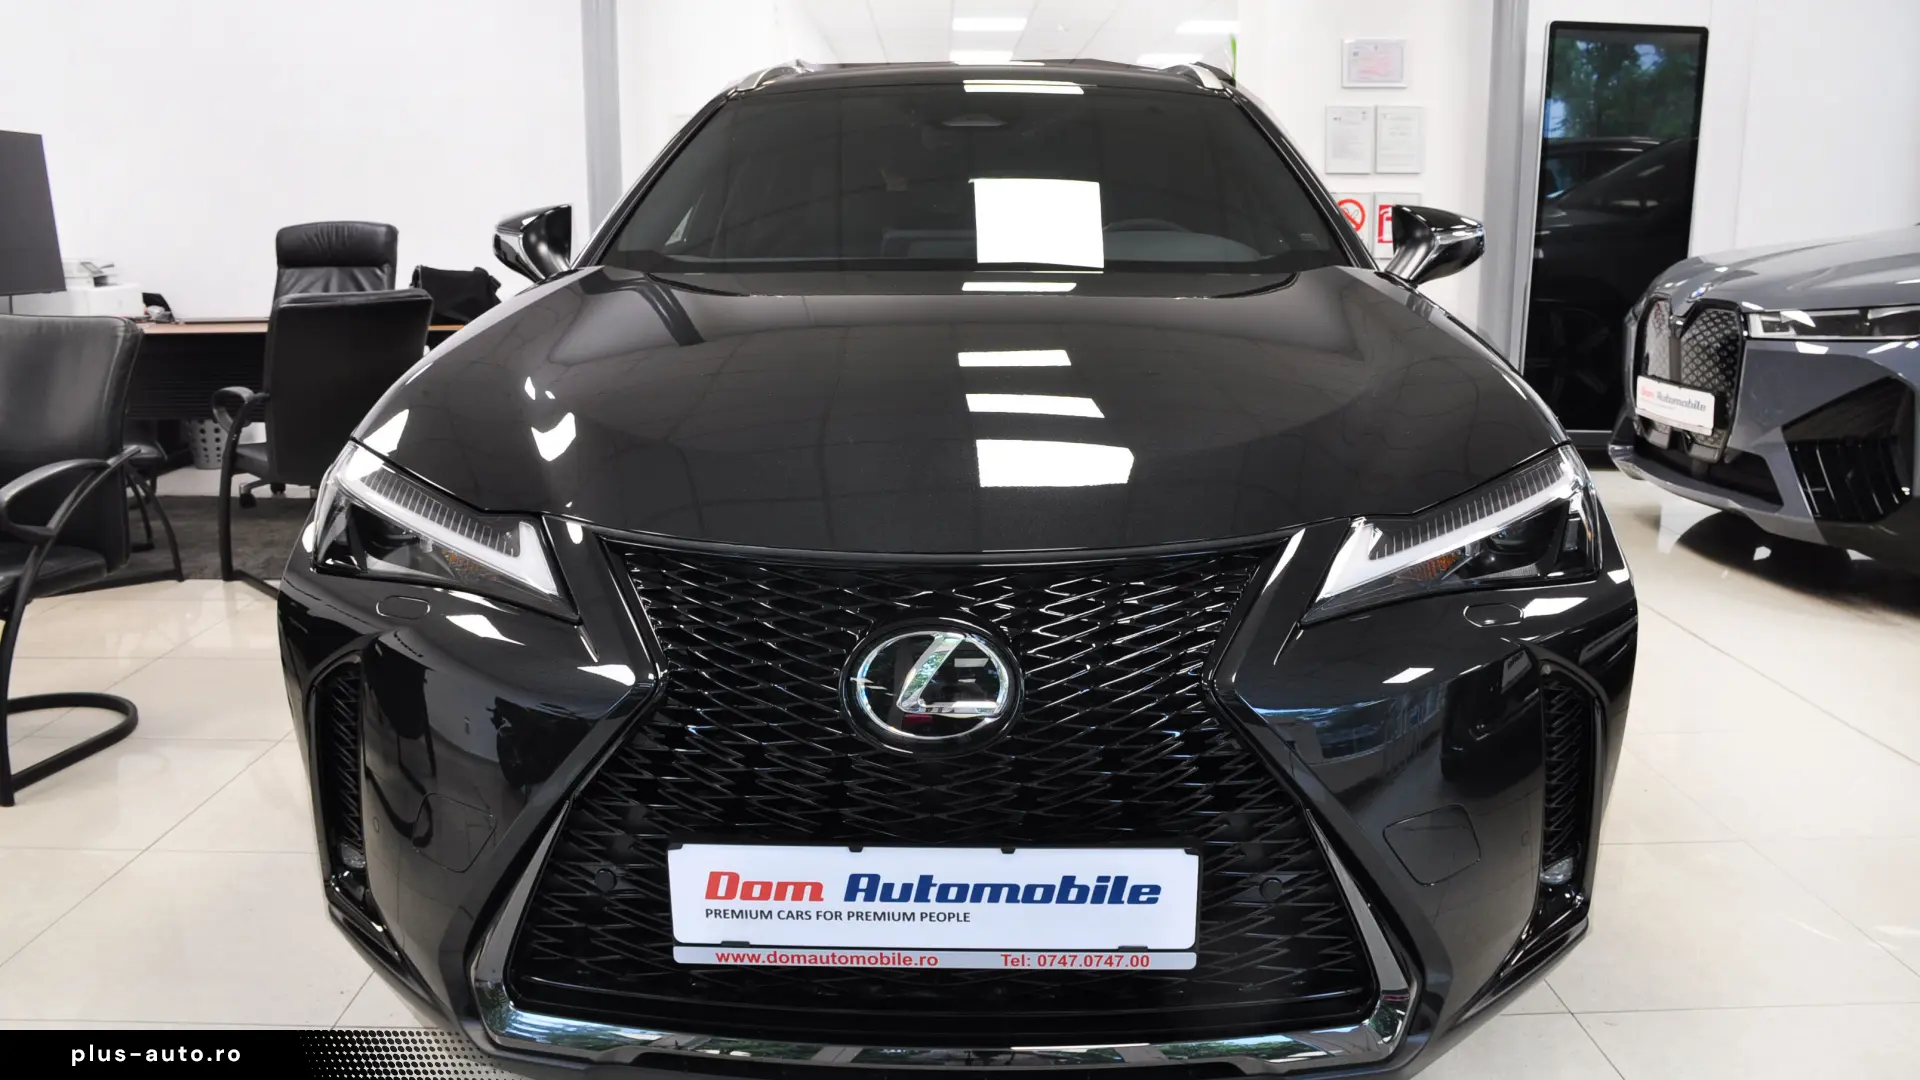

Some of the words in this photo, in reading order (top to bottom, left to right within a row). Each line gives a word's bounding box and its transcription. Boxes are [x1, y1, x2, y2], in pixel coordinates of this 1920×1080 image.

[705, 871, 824, 902] Dom
[843, 873, 1162, 905] Automobile
[705, 908, 773, 920] PREMIUM
[777, 909, 812, 921] CARS
[816, 910, 843, 921] FOR
[847, 911, 916, 922] PREMIUM
[920, 911, 971, 923] PEOPLE
[715, 951, 939, 967] www.domautomobile.ro
[1001, 953, 1032, 967] Tel:
[1037, 953, 1151, 968] 0747.0747.00
